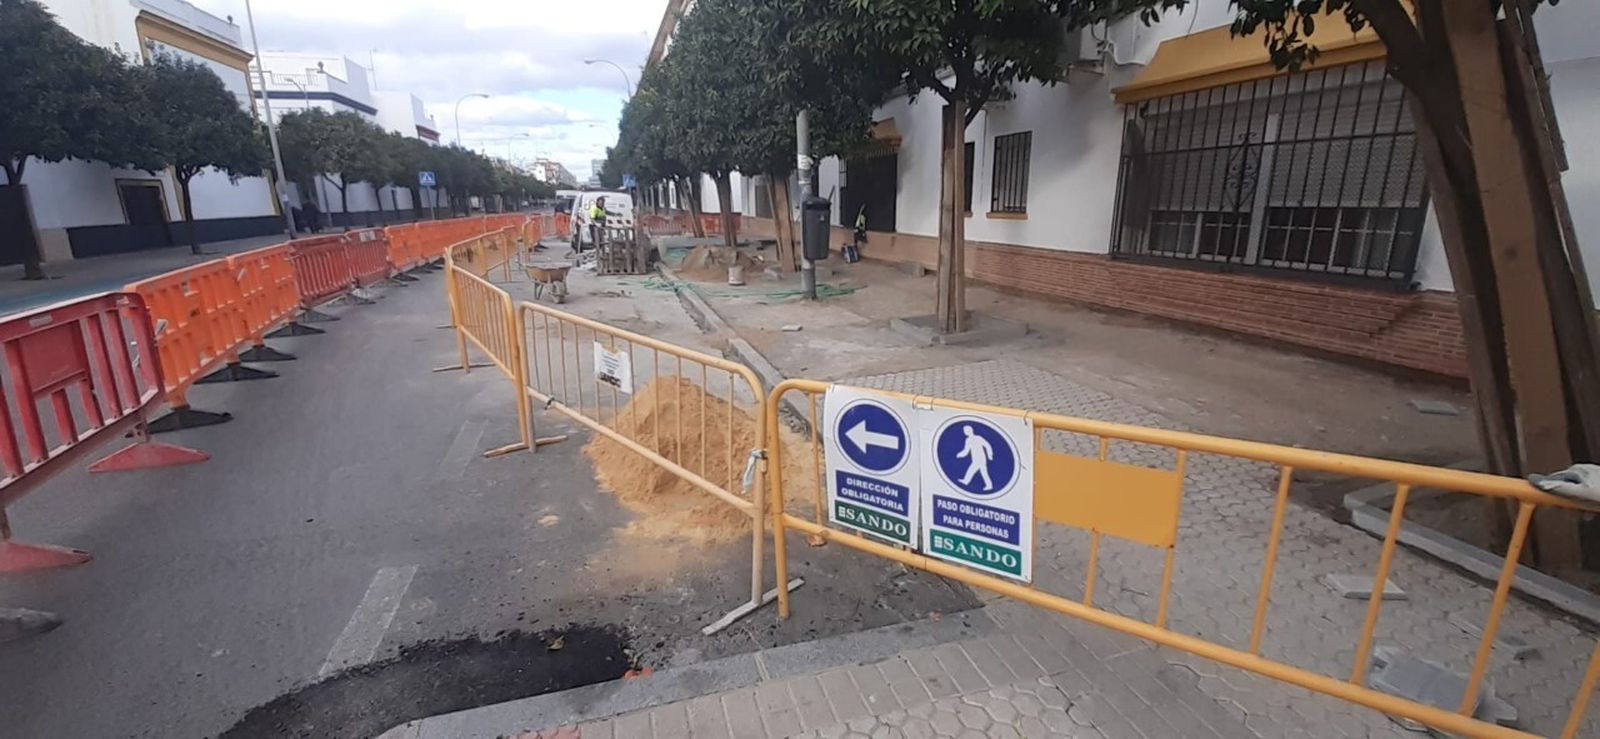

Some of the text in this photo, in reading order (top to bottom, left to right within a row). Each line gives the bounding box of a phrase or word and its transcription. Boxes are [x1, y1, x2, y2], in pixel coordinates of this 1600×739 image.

[846, 477, 898, 497] DIRECCIÓN
[841, 488, 904, 512] OBLIGATORIA
[937, 499, 1016, 525] PASO OBLIGATORIO
[845, 507, 907, 537] SANDO
[943, 515, 1009, 539] PARA PERSONAS
[943, 537, 1017, 568] SANDO
